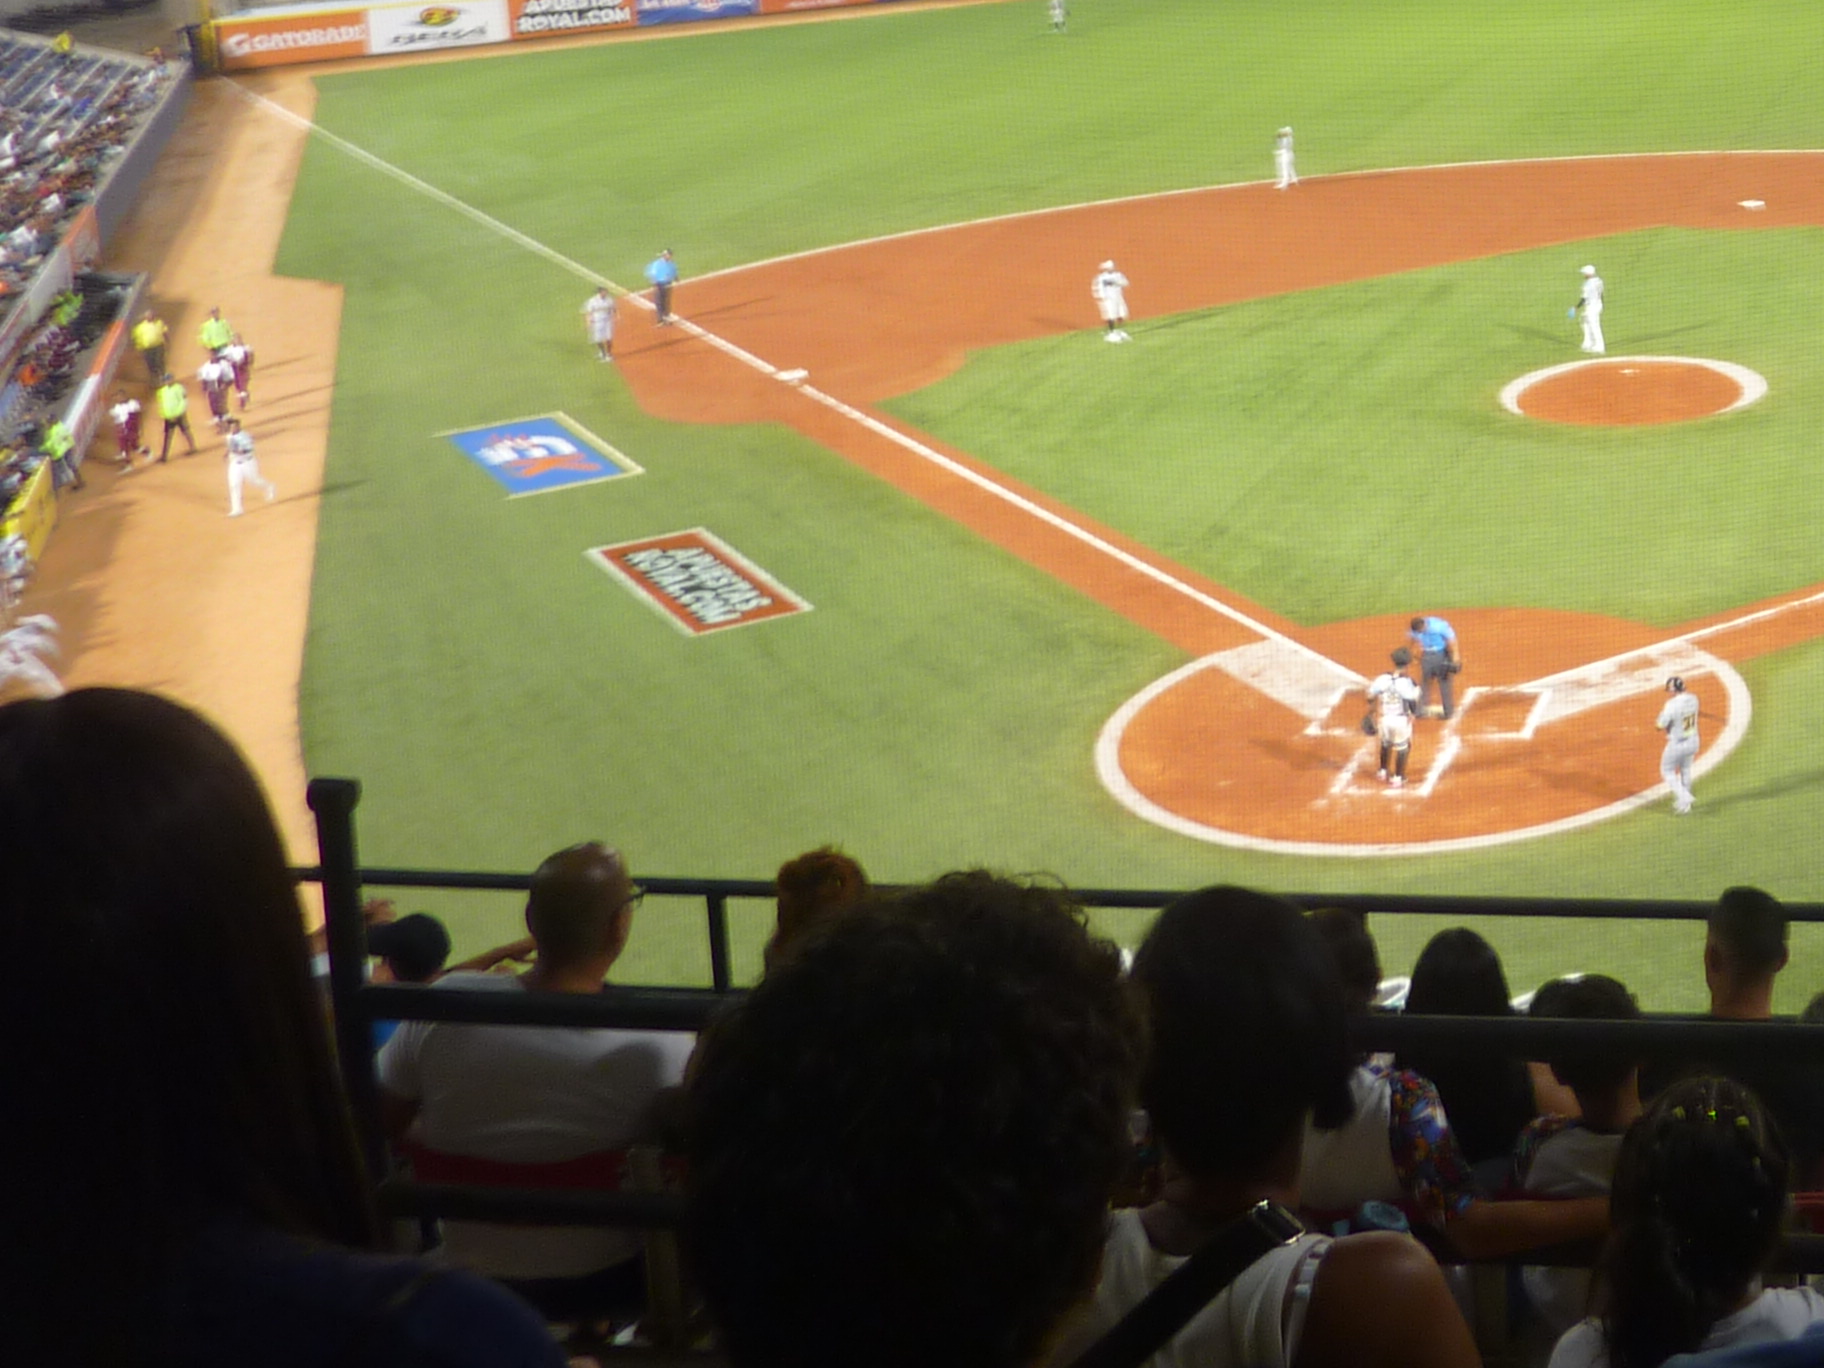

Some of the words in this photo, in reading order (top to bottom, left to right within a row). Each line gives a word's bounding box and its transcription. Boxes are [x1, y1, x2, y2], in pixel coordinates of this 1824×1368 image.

[252, 23, 366, 53] GATORADE
[517, 7, 632, 33] ROYAL.COM
[623, 548, 743, 625] ROYAL.COM
[667, 546, 774, 612] APUESTAS
